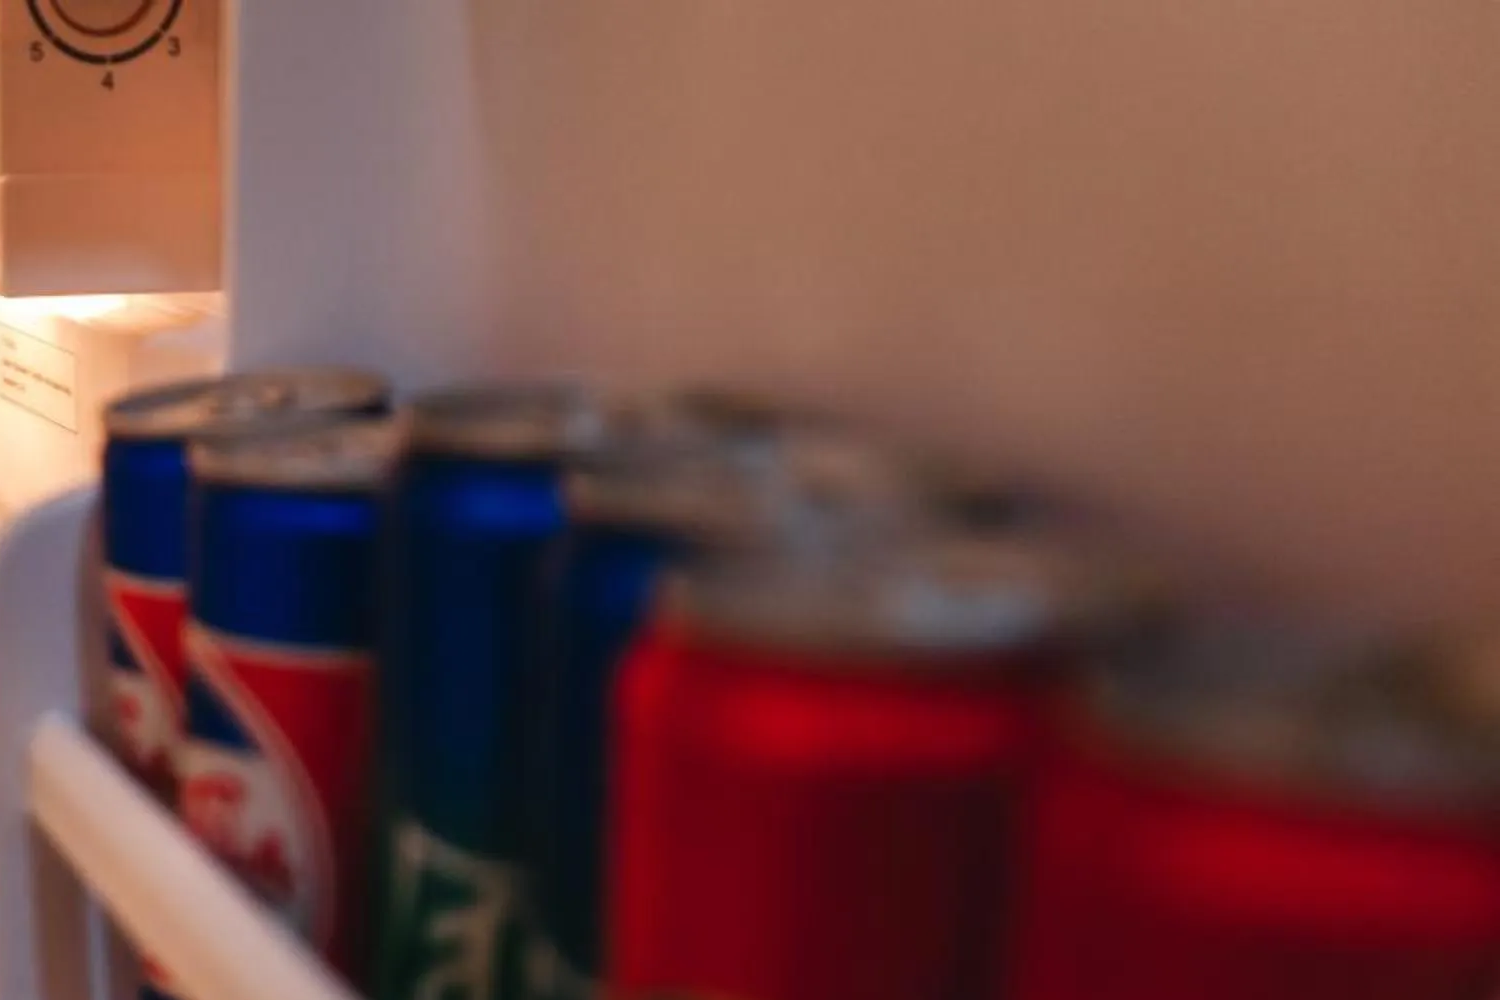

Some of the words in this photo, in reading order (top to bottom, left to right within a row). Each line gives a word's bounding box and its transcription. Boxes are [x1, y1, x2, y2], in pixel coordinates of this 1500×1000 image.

[29, 39, 45, 62] 5
[168, 35, 182, 57] 3
[100, 70, 115, 91] 4
